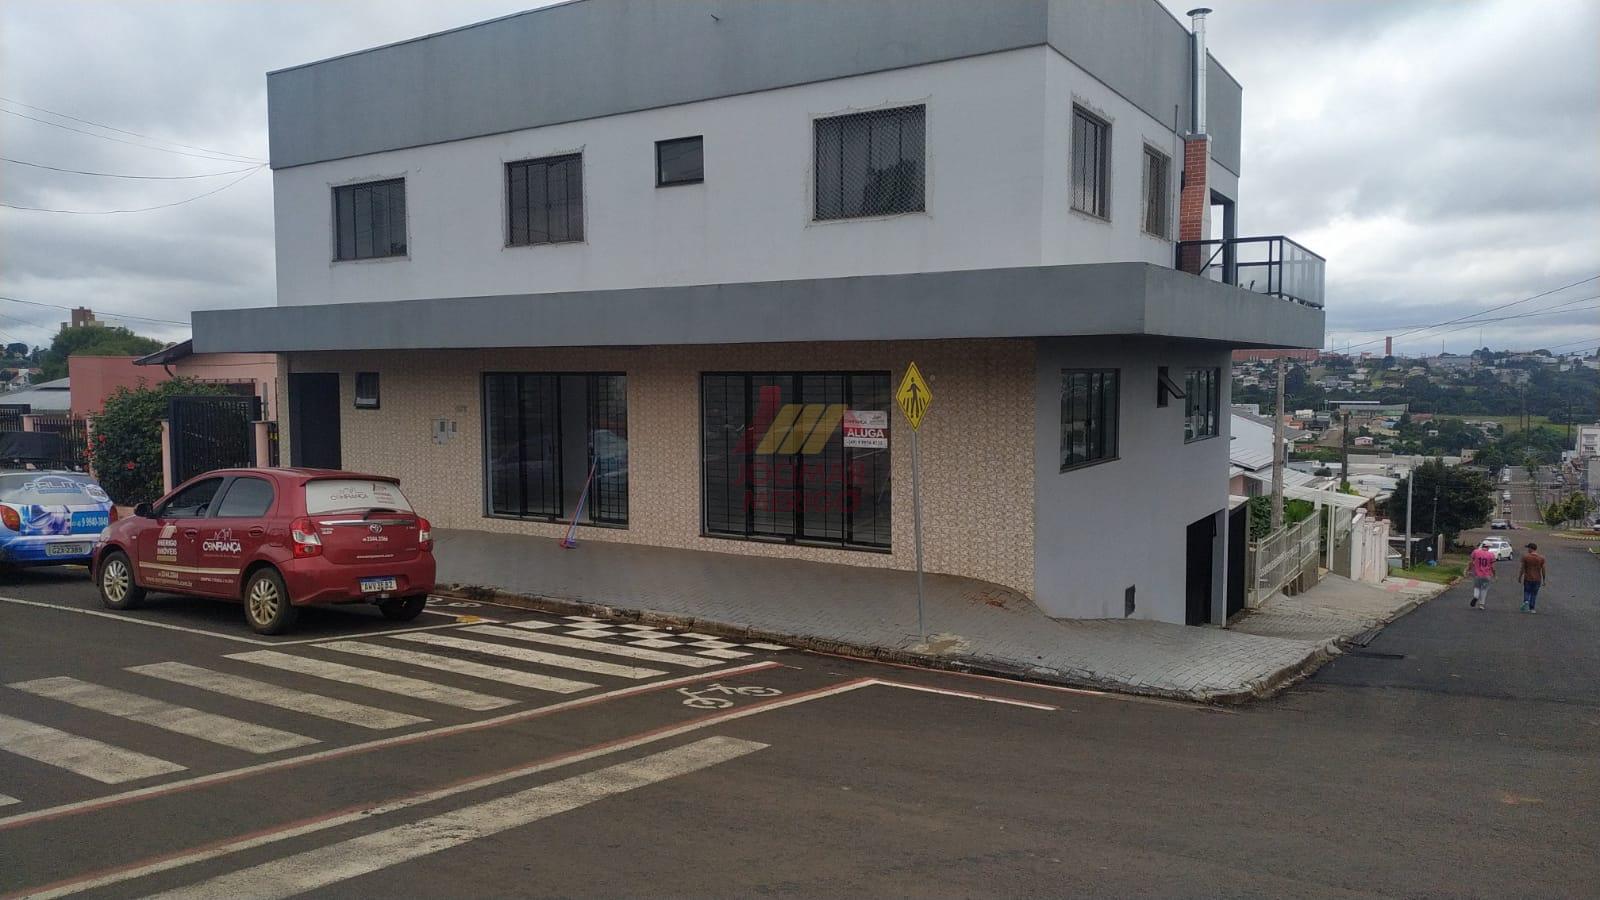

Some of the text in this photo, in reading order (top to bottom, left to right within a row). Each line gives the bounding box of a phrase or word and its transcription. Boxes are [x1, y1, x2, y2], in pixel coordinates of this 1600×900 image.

[847, 429, 885, 438] ALUGA
[202, 541, 241, 554] CONFIANÇA
[1479, 557, 1488, 568] 10
